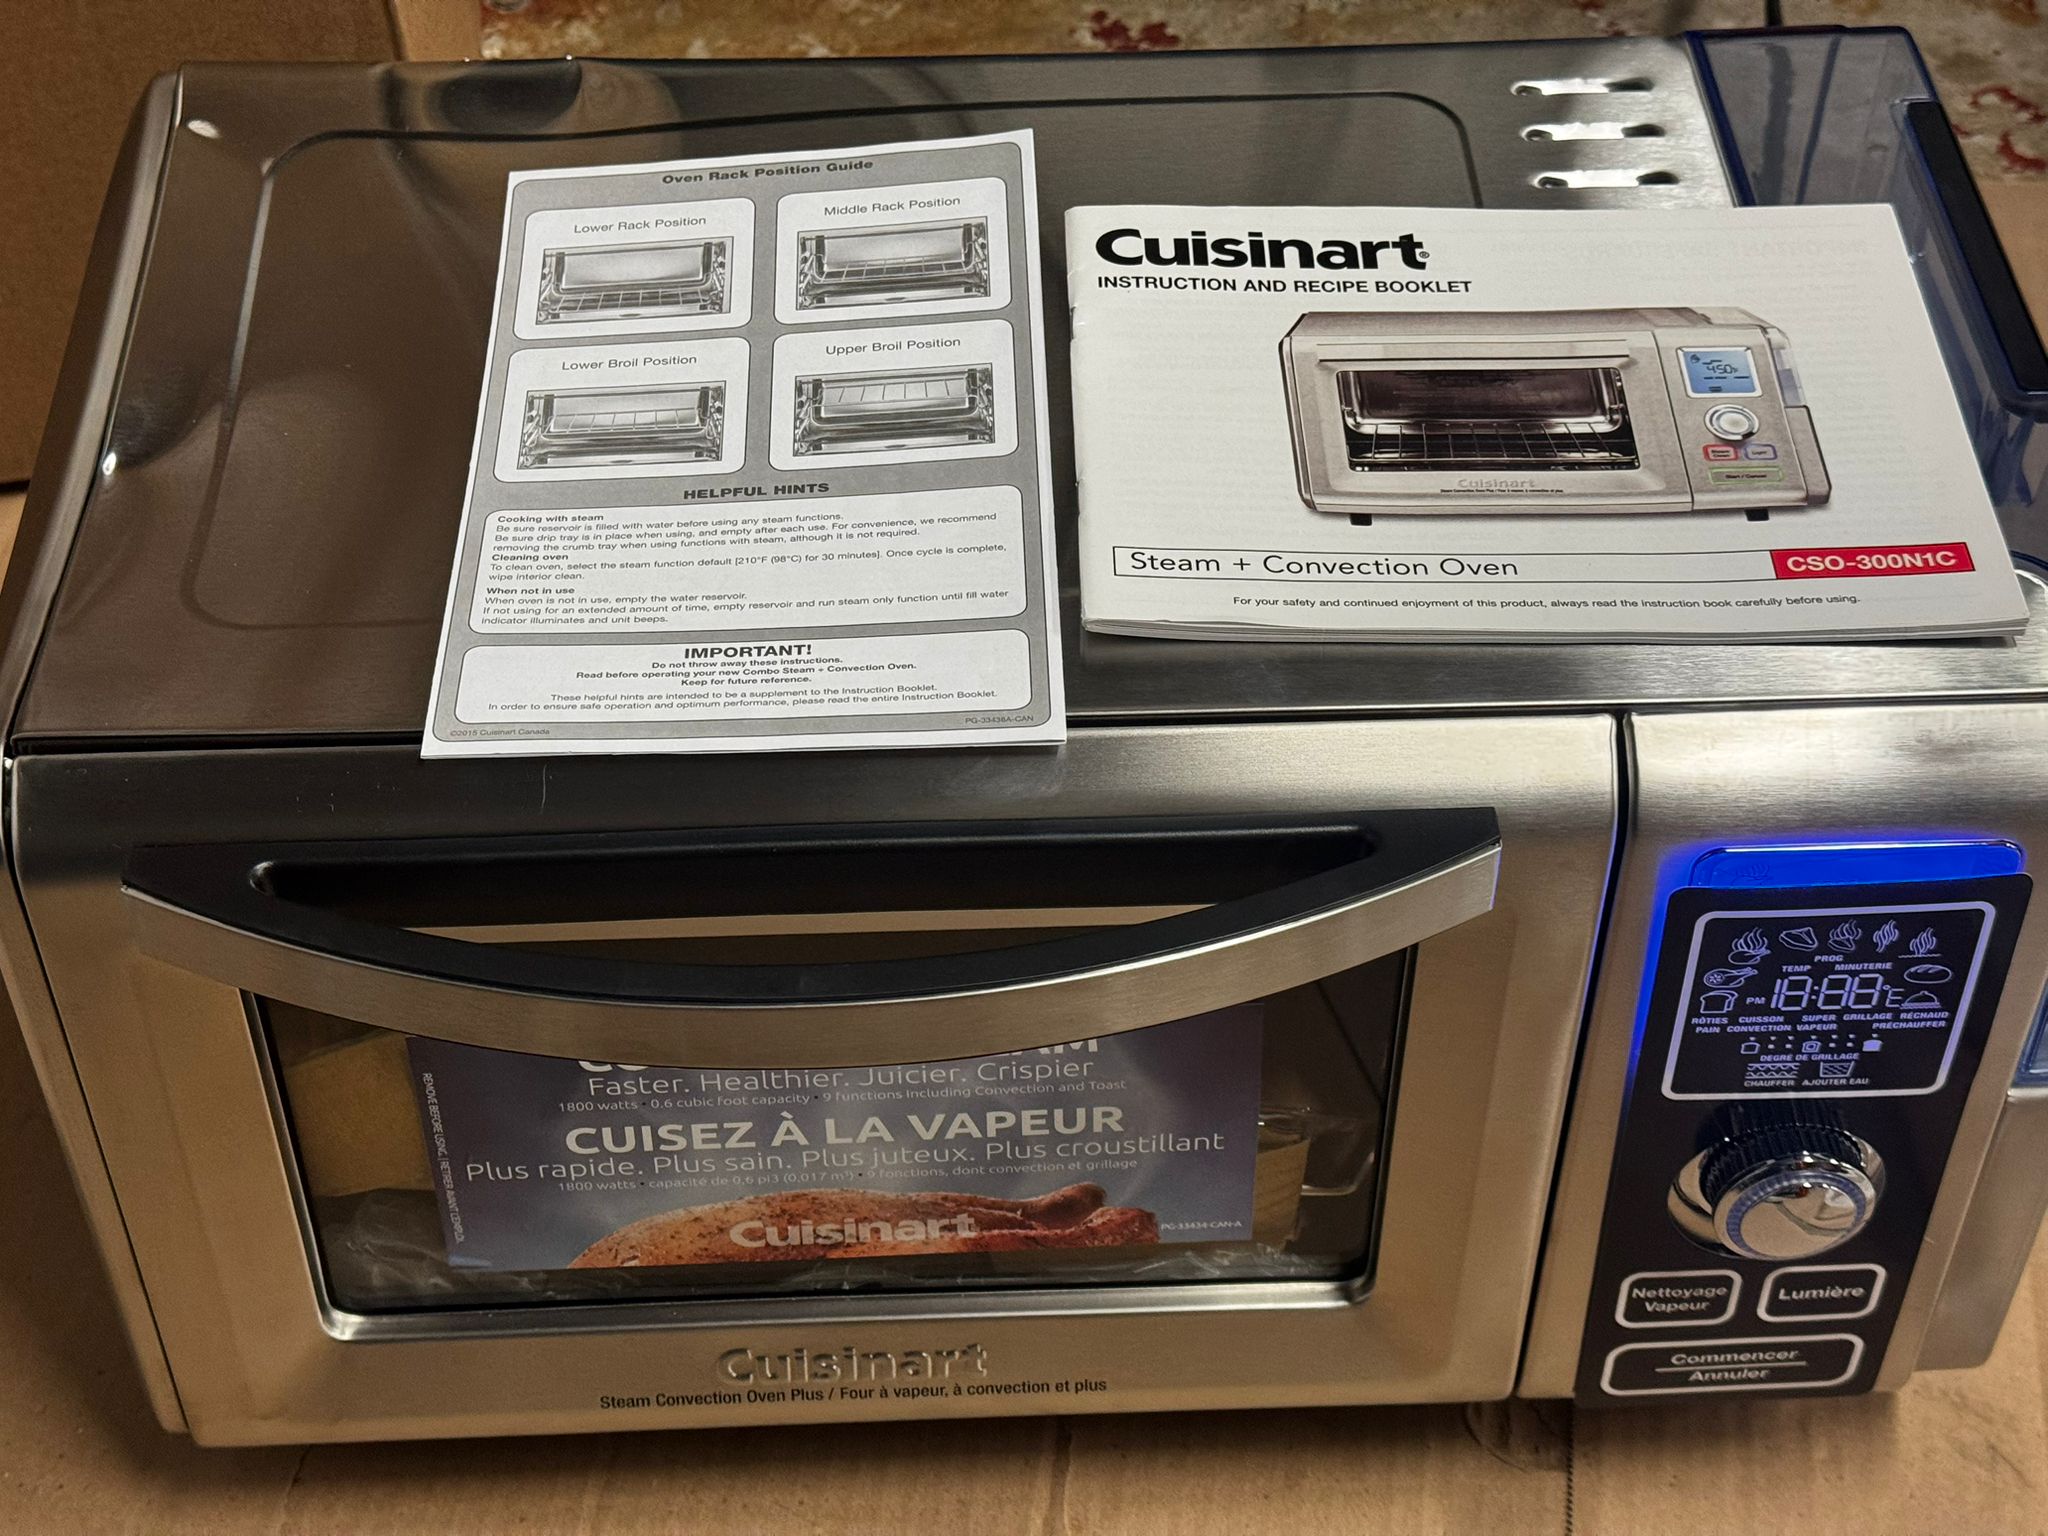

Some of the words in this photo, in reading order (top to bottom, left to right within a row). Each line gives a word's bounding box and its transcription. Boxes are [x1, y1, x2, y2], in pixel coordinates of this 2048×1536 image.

[662, 174, 703, 184] Oven
[708, 169, 749, 181] Rack
[754, 165, 821, 177] Position
[826, 160, 873, 172] Guide
[824, 204, 868, 216] Middle
[871, 201, 905, 212] Rack
[908, 197, 961, 209] Position
[573, 223, 614, 234] Lower
[617, 219, 650, 231] Rack
[654, 217, 706, 228] Position
[1098, 275, 1237, 291] INSTRUCTION
[1243, 279, 1287, 292] AND
[1293, 280, 1369, 293] RECIPE
[1374, 280, 1472, 293] BOOKLET
[825, 344, 868, 356] Upper
[872, 340, 902, 352] Broil
[906, 338, 961, 350] Position
[561, 361, 604, 371] Lower
[608, 357, 639, 368] Broil
[643, 355, 697, 366] Position
[683, 486, 767, 500] HELPFUL
[773, 482, 830, 495] HINTS
[497, 515, 543, 524] Cooking
[491, 553, 540, 562] Cleaning
[1130, 551, 1220, 572] Steam
[1262, 554, 1428, 575] Convection
[1439, 557, 1518, 576] Oven
[1786, 550, 1957, 572] CSO-300N1C
[488, 573, 513, 582] wipe
[515, 573, 552, 581] interior
[554, 572, 585, 580] clean.
[486, 587, 518, 595] When
[520, 587, 539, 595] not
[1233, 596, 1252, 605] For
[1254, 598, 1280, 607] your
[1282, 598, 1316, 608] safety
[1319, 599, 1340, 607] and
[1343, 599, 1399, 607] continued
[1401, 599, 1459, 609] enjoyment
[1462, 599, 1473, 607] of
[1476, 599, 1497, 607] this
[1500, 599, 1548, 609] product,
[1550, 599, 1589, 609] always
[1591, 599, 1617, 607] read
[1619, 599, 1639, 607] the
[1641, 599, 1700, 608] instruction
[1702, 599, 1733, 608] book
[1734, 597, 1783, 607] carefully
[1785, 596, 1823, 605] before
[1825, 594, 1861, 604] using.
[684, 644, 811, 659] IMPORTANT!
[668, 661, 686, 669] not
[780, 657, 843, 665] instructions.
[681, 679, 708, 687] Keep
[727, 677, 758, 685] future
[760, 676, 812, 684] reference.
[1813, 954, 1844, 962] PROG
[1781, 964, 1812, 973] TEMP
[1834, 961, 1893, 971] MINUTERIE
[1745, 996, 1766, 1005] PM
[1738, 1015, 1784, 1023] CUISSON
[1801, 1014, 1837, 1022] SUPER
[1842, 1012, 1893, 1021] GRILLAGE
[1899, 1011, 1949, 1020] RÉCHAUD
[1726, 1024, 1792, 1033] CONVECTION
[1796, 1023, 1838, 1031] VAPEUR
[1871, 1020, 1946, 1029] PRÉCHAUFFER
[588, 1076, 690, 1096] Faster.
[700, 1069, 849, 1092] Healthier.
[858, 1065, 967, 1086] Juicier.
[977, 1059, 1094, 1082] Crispier
[1743, 1079, 1795, 1087] CHAUFFER
[1801, 1078, 1847, 1086] AJOUTER
[1848, 1077, 1869, 1085] EAU
[565, 1121, 756, 1155] CUISEZ
[770, 1110, 810, 1147] À
[825, 1116, 895, 1144] LA
[906, 1106, 1124, 1140] VAPEUR
[466, 1162, 529, 1182] Plus
[538, 1156, 643, 1182] rapide.
[653, 1154, 716, 1174] Plus
[724, 1152, 791, 1171] sain.
[802, 1148, 863, 1168] Plus
[871, 1147, 975, 1169] juteux.
[986, 1140, 1047, 1160] Plus
[1056, 1132, 1225, 1157] croustillant
[729, 1212, 977, 1249] Cuisinart
[1631, 1287, 1732, 1301] Nettoyage
[1778, 1286, 1865, 1300] Lumière
[1644, 1301, 1710, 1313] Vapeur
[719, 1344, 989, 1383] Cuisinart
[1670, 1350, 1799, 1365] Commencer
[1688, 1368, 1769, 1381] Annuler
[599, 1395, 651, 1409] Steam
[655, 1391, 742, 1407] Convection
[746, 1390, 786, 1403] Oven
[790, 1388, 824, 1402] Plus
[839, 1387, 875, 1400] Four
[879, 1385, 889, 1399] à
[893, 1385, 949, 1400] vapeur,
[952, 1383, 962, 1396] à
[966, 1380, 1050, 1396] convection
[1054, 1379, 1070, 1393] et
[1074, 1378, 1107, 1395] plus
